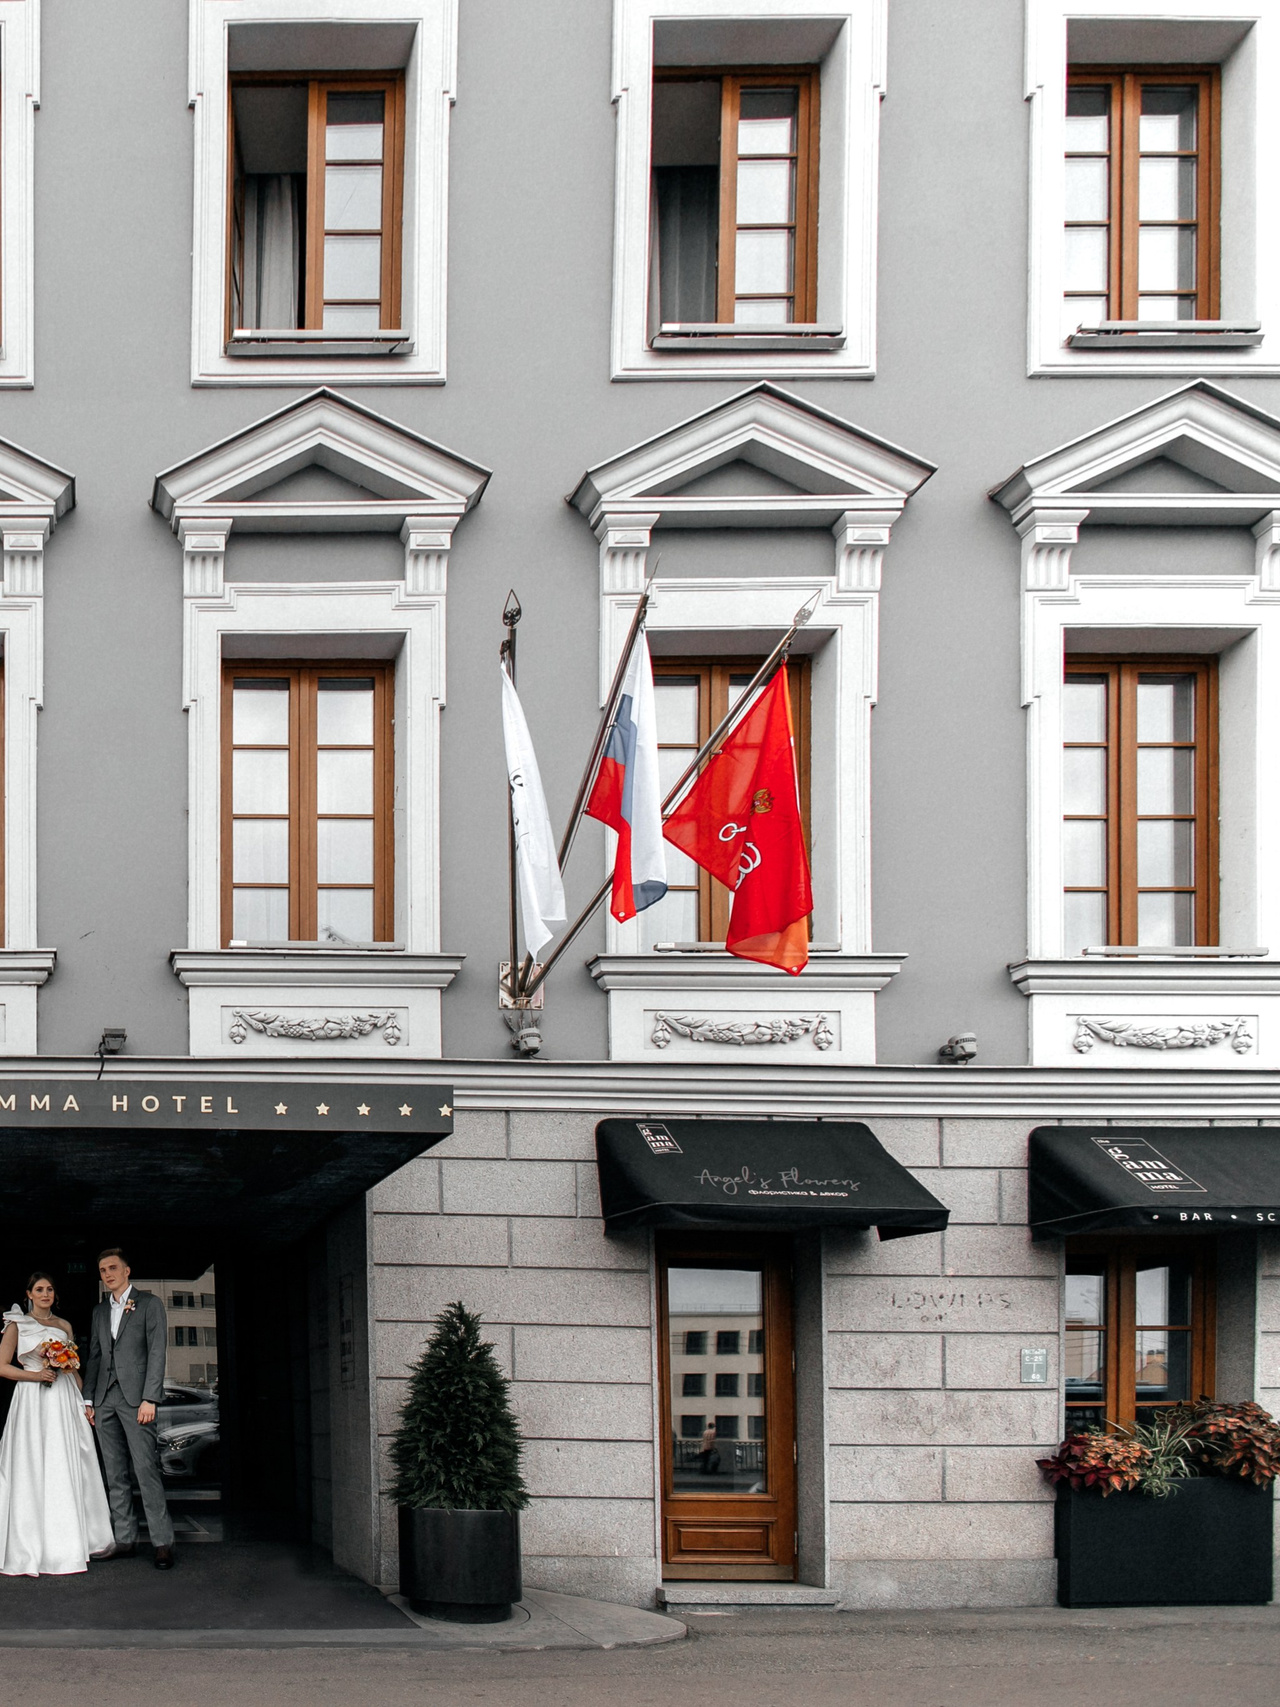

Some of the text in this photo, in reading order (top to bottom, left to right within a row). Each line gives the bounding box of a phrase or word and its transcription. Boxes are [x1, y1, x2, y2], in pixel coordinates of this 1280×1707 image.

[112, 1094, 239, 1113] HOTEL
[1108, 1146, 1130, 1160] g
[1122, 1160, 1170, 1170] am
[778, 1166, 861, 1192] Flowers
[1134, 1171, 1184, 1181] ma
[1179, 1212, 1213, 1221] BAR
